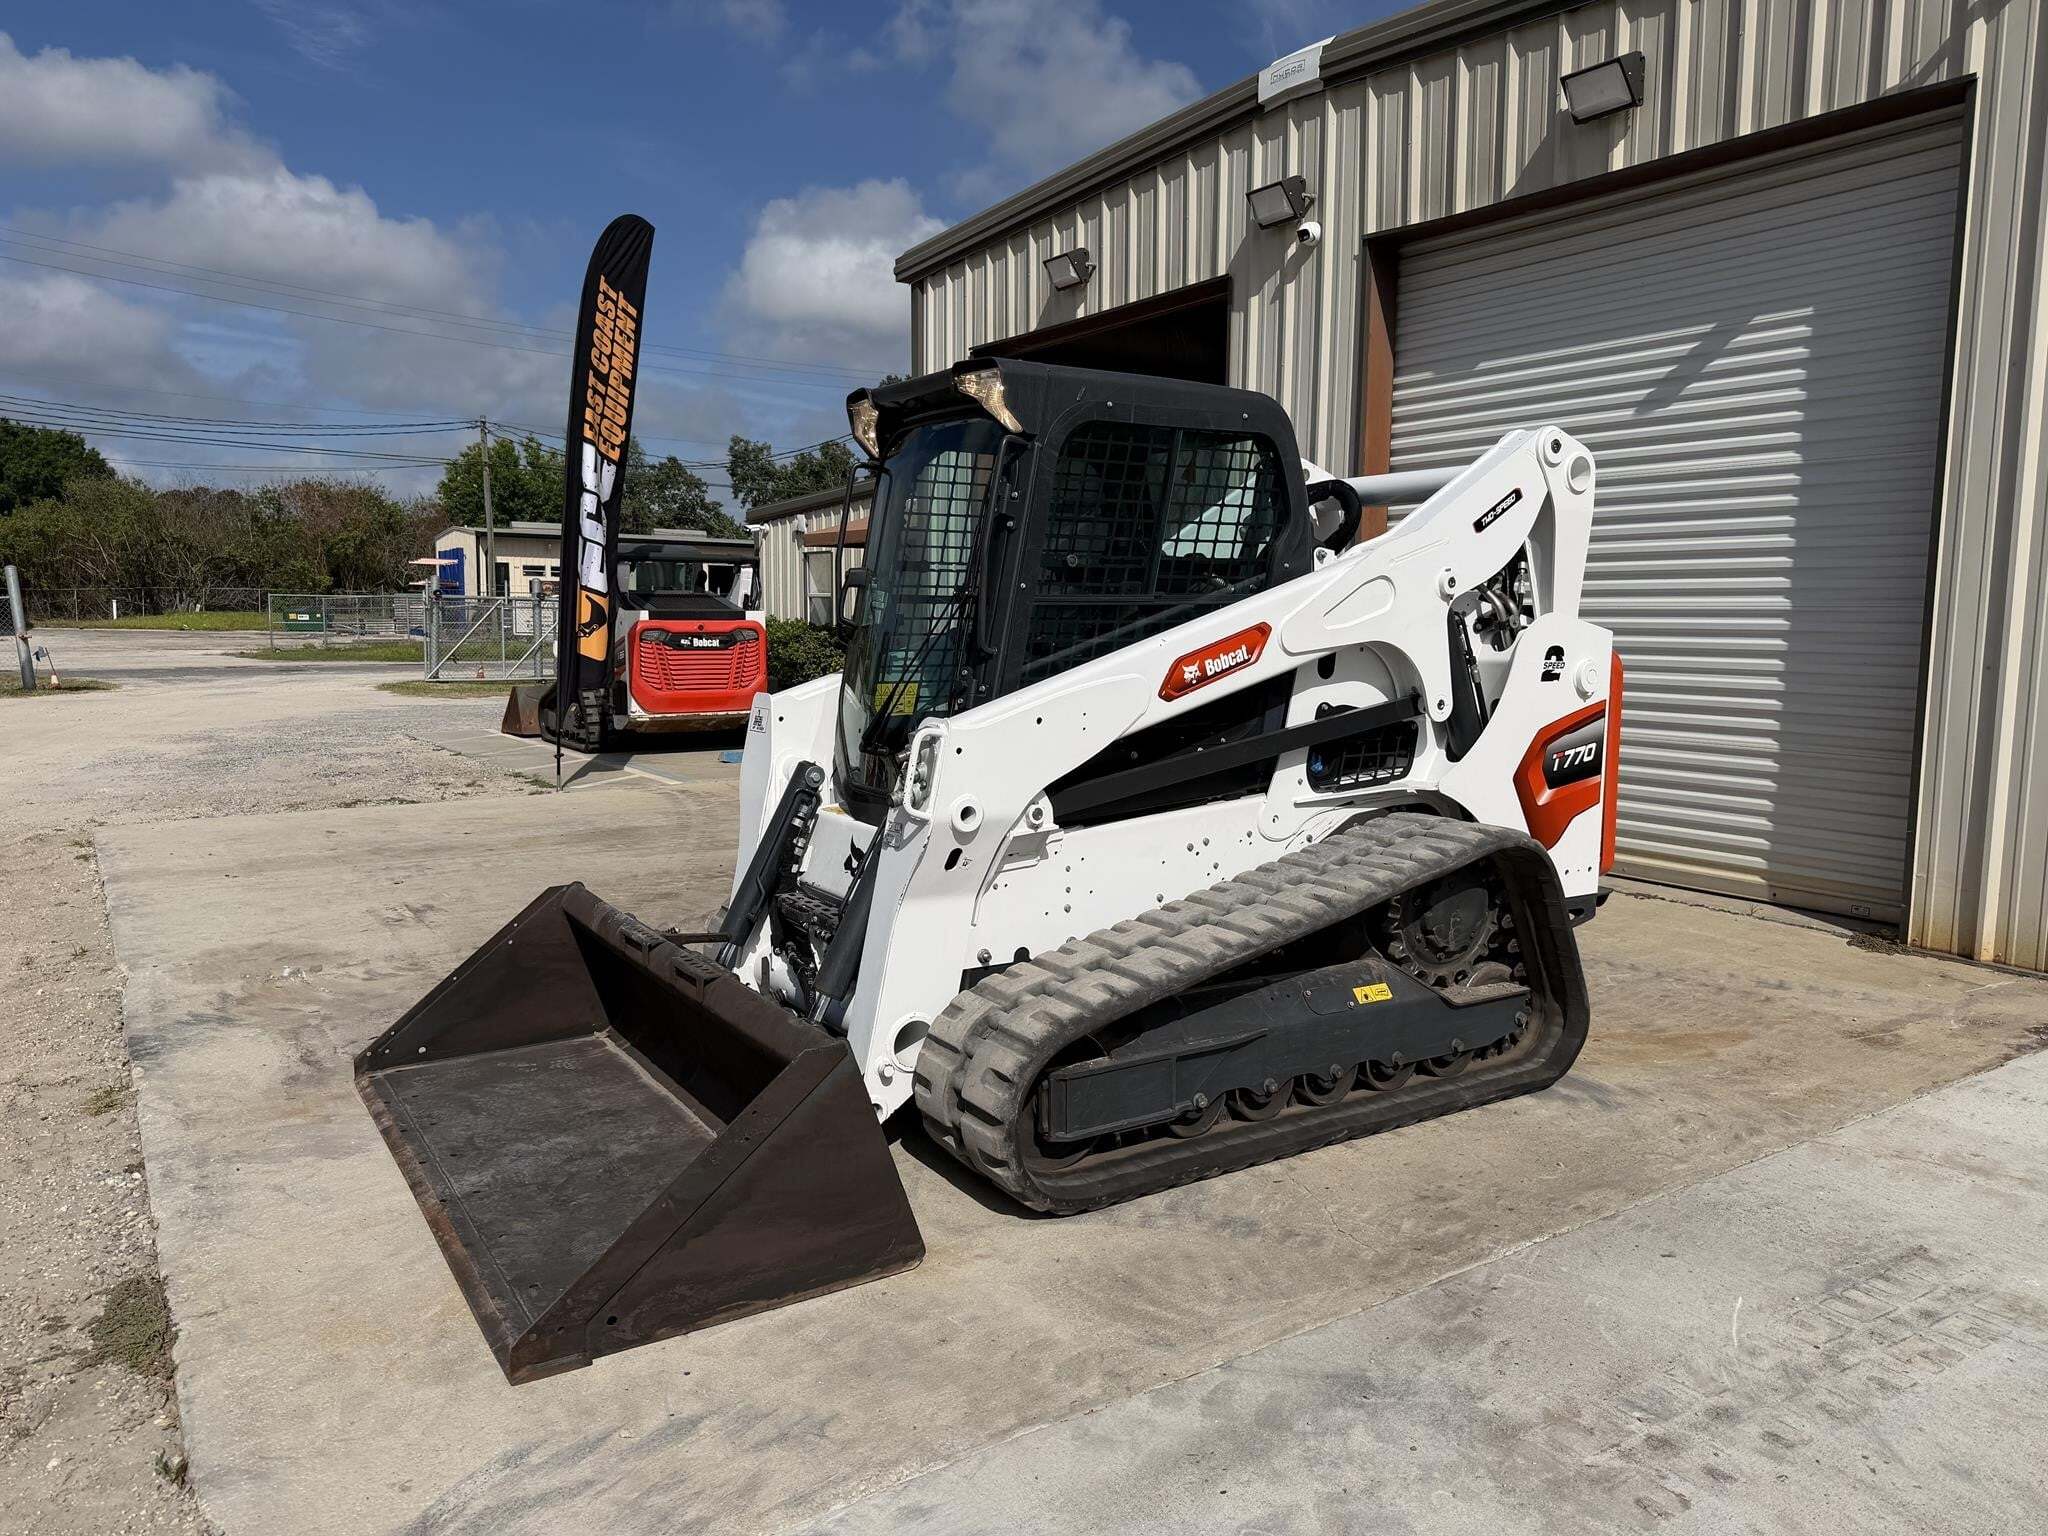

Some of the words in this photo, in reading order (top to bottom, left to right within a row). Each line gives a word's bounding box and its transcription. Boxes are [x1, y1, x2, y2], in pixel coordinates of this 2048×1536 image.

[590, 274, 618, 375] COAST
[598, 290, 638, 462] EQUIPMENT
[583, 369, 607, 447] EAST
[1480, 493, 1517, 527] TWO-SPEED
[692, 637, 720, 648] Bobcat
[1203, 644, 1250, 677] Bobcat
[1543, 661, 1566, 670] SPEED
[1552, 742, 1597, 772] T770
